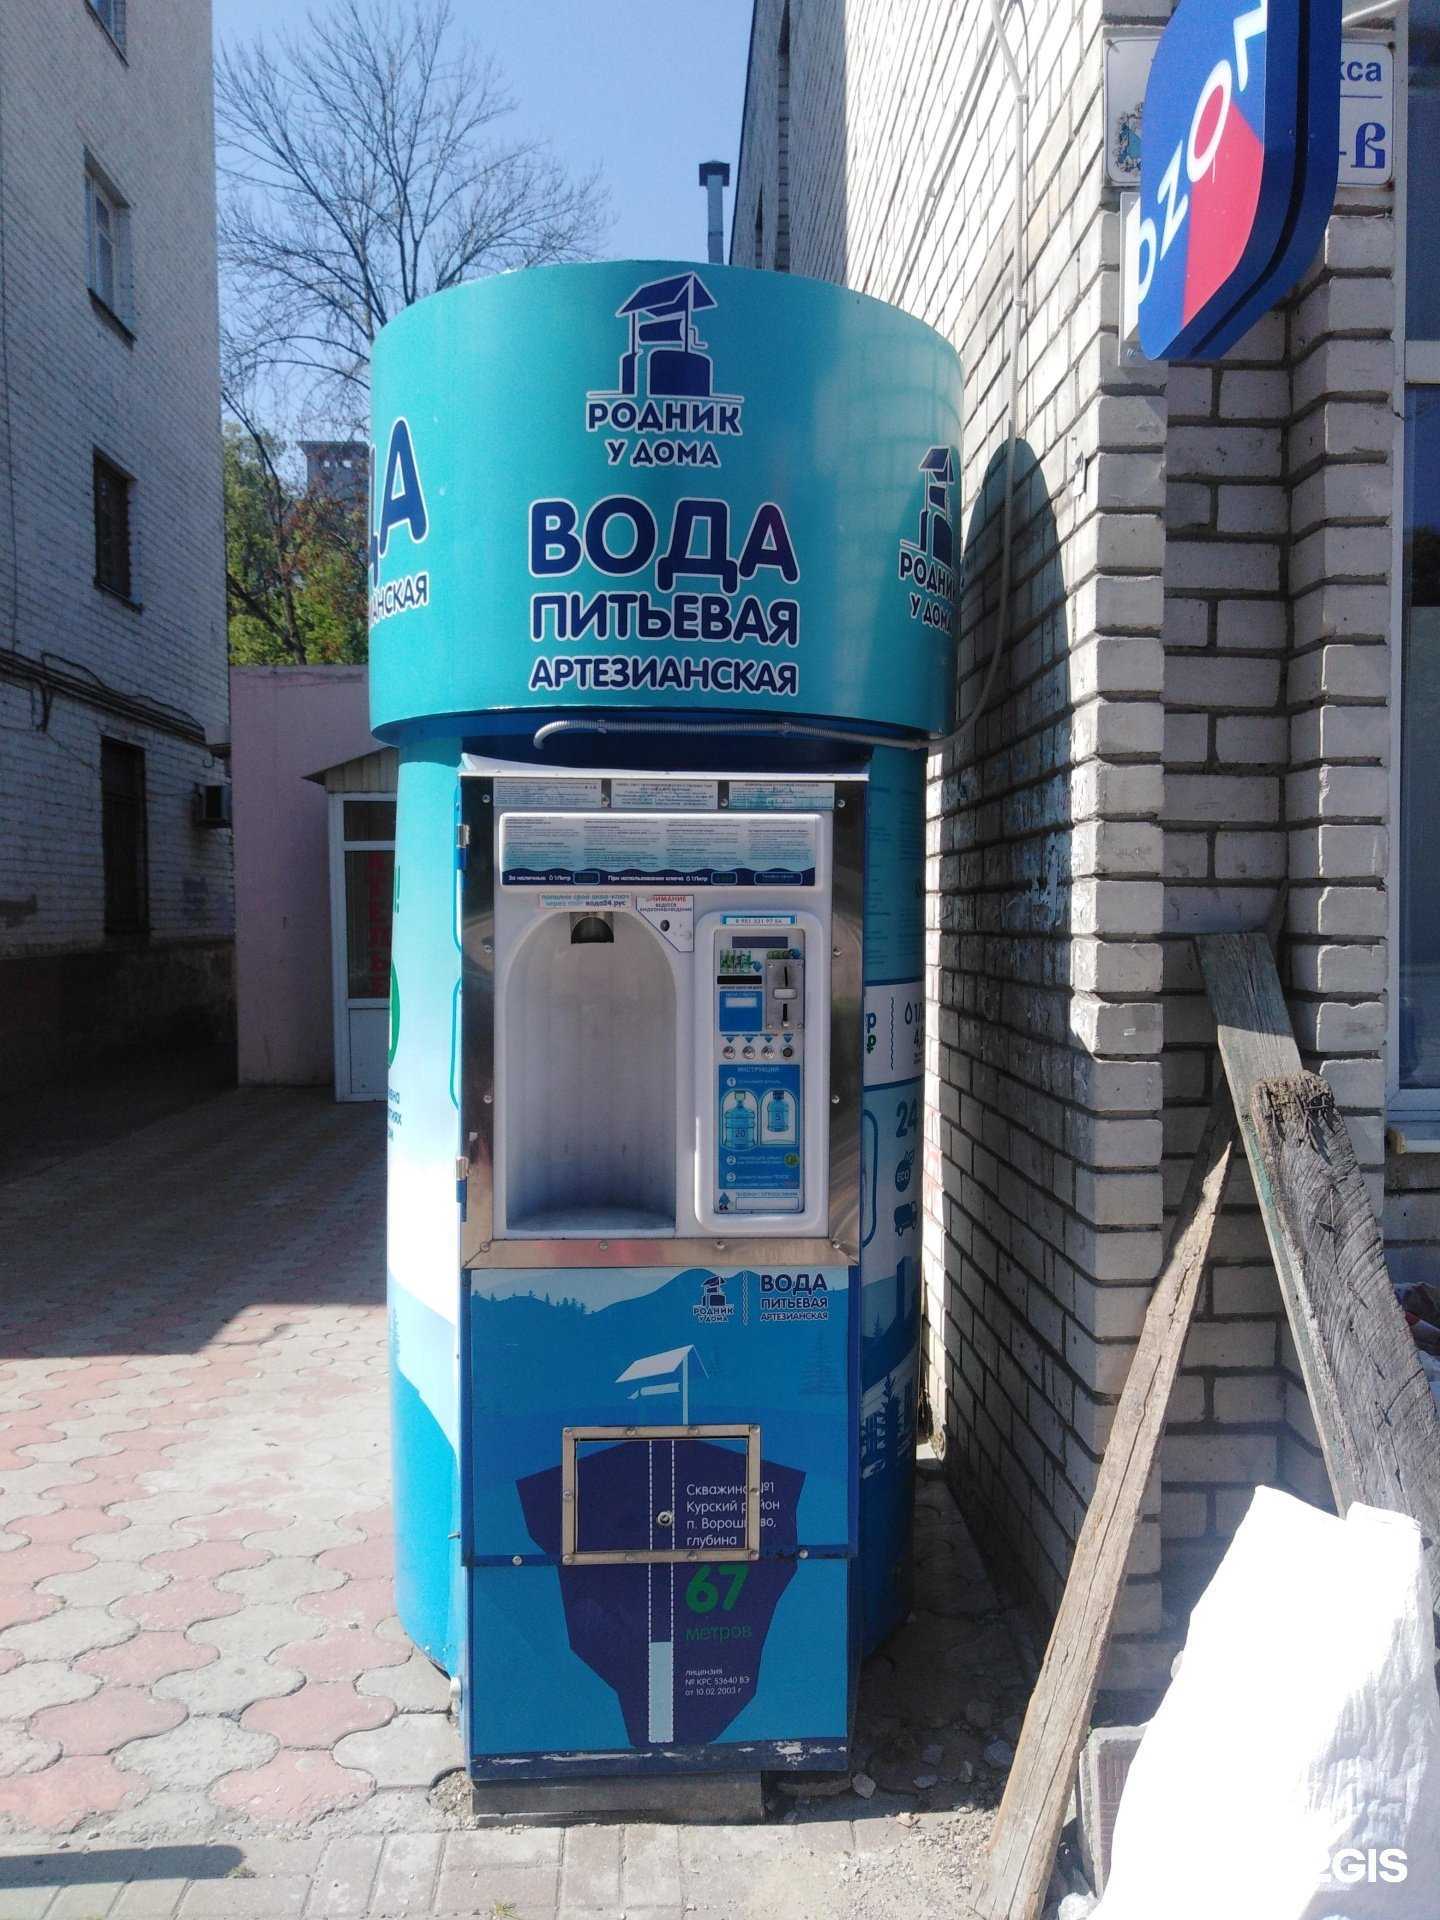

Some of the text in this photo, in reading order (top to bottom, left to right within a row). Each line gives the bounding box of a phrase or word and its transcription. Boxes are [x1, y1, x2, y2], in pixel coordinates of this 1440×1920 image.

[587, 401, 743, 435] РОДНИК
[606, 439, 721, 467] У ДОМА
[529, 495, 801, 594] ВОДА
[898, 549, 954, 602] РОДНИ
[909, 591, 922, 619] У
[530, 592, 799, 647] ПИТЬЕВАЯ
[529, 655, 799, 695] АРТЕЗИАНСКАЯ
[760, 1272, 829, 1296] ВОДА
[692, 1305, 735, 1316] РОДНИК
[760, 1297, 829, 1309] ПИТЬЕВАЯ
[705, 1315, 729, 1323] ДОМА
[760, 1311, 829, 1321] АРТЕЗИАНСКАЯ
[686, 1499, 738, 1516] Курский
[686, 1534, 738, 1548] глубина
[686, 1564, 751, 1614] 67
[686, 1625, 752, 1644] метров
[686, 1667, 723, 1677] лицензия
